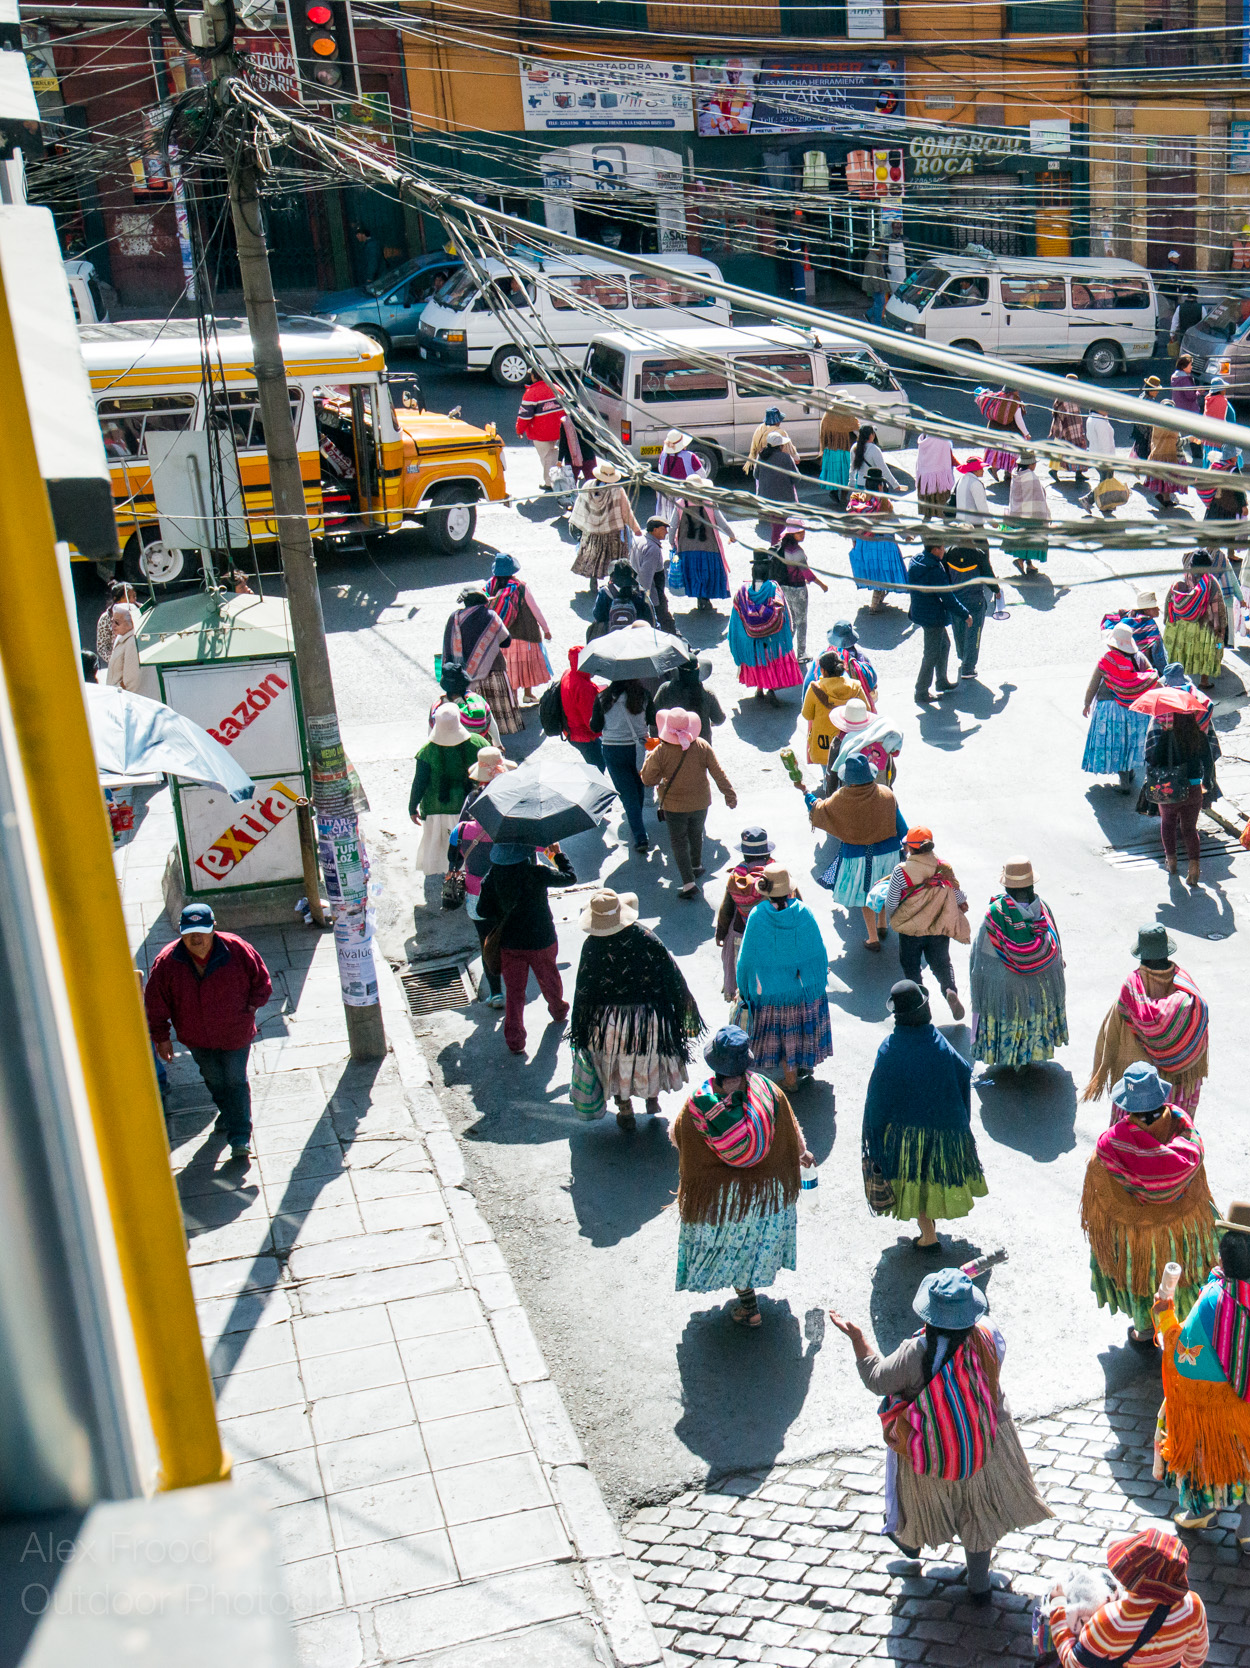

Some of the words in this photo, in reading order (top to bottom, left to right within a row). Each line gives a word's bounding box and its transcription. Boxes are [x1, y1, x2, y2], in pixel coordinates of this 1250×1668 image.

[808, 78, 865, 87] HERRAMIENTA
[782, 89, 848, 103] CARAN
[913, 157, 975, 175] ROCA
[195, 781, 300, 881] extra
